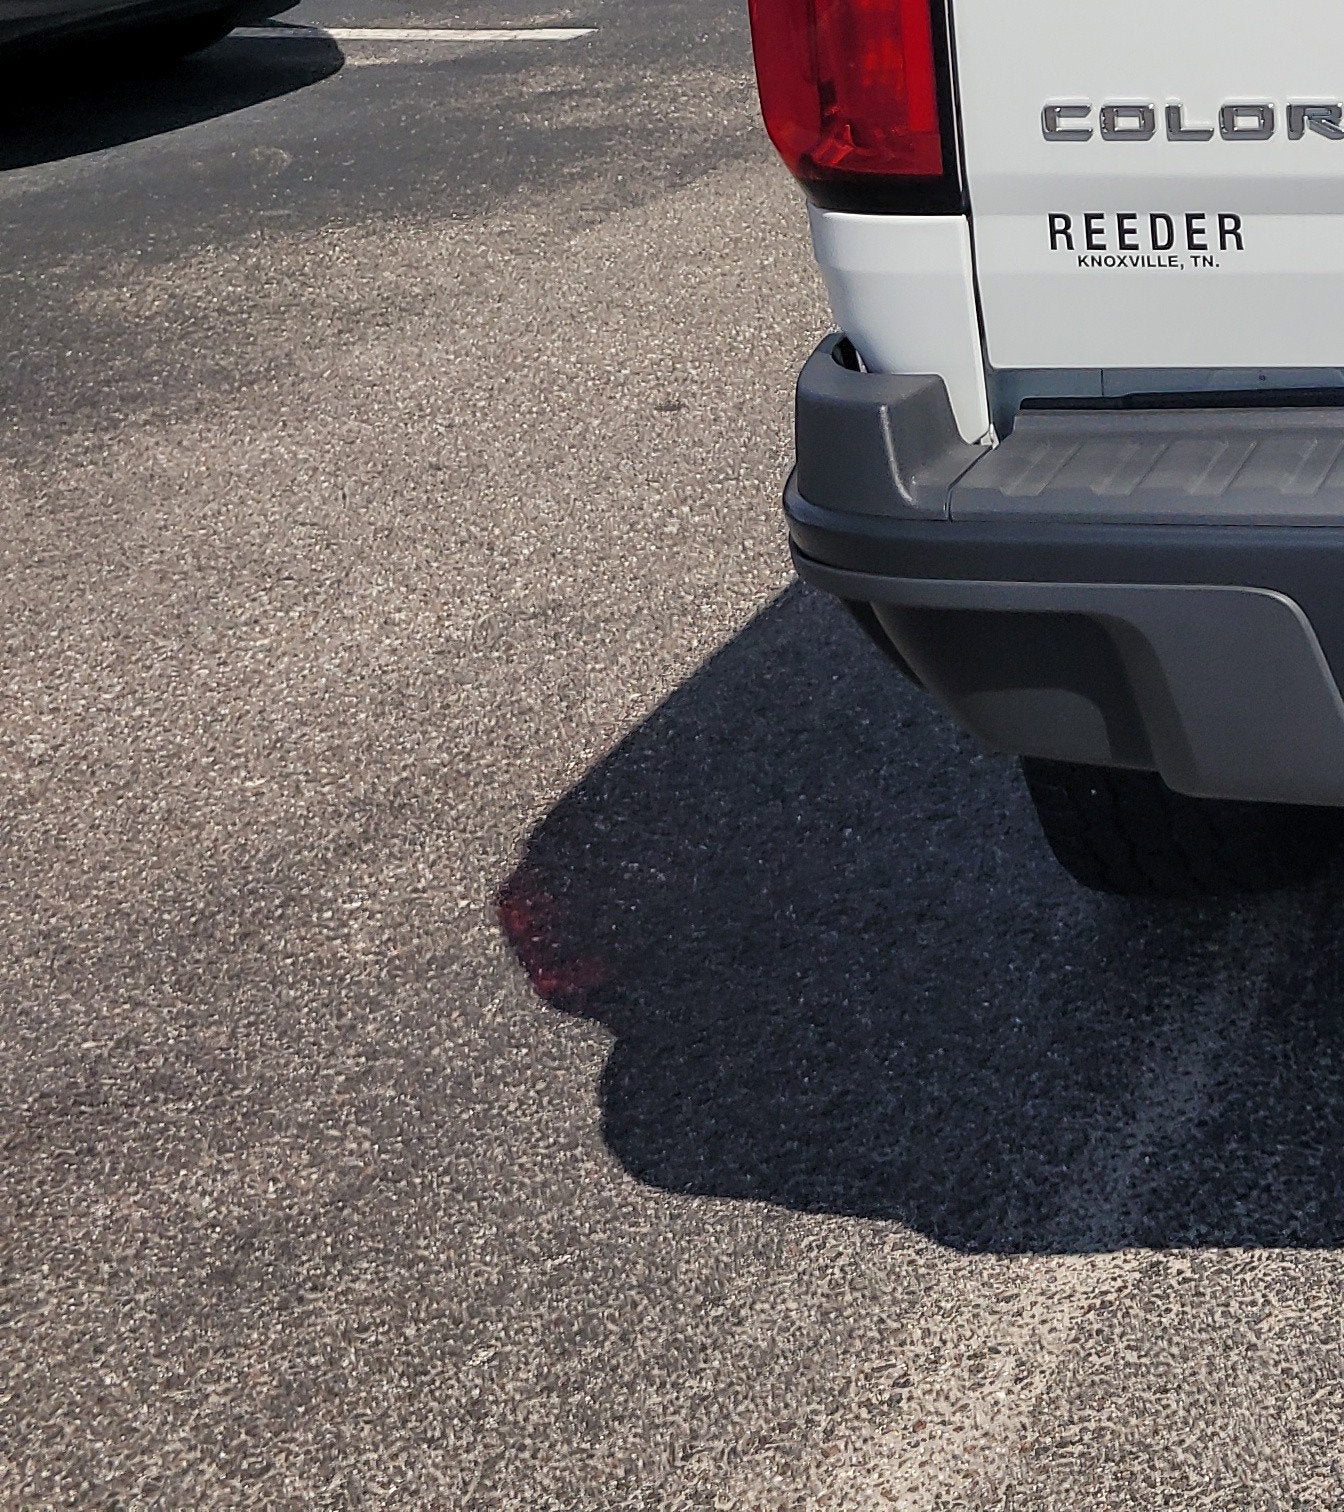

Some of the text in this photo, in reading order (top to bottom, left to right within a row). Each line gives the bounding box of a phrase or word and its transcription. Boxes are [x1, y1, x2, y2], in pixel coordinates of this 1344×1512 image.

[1048, 213, 1244, 251] REEDER
[1077, 255, 1220, 270] KNOXVILLE, TN.
